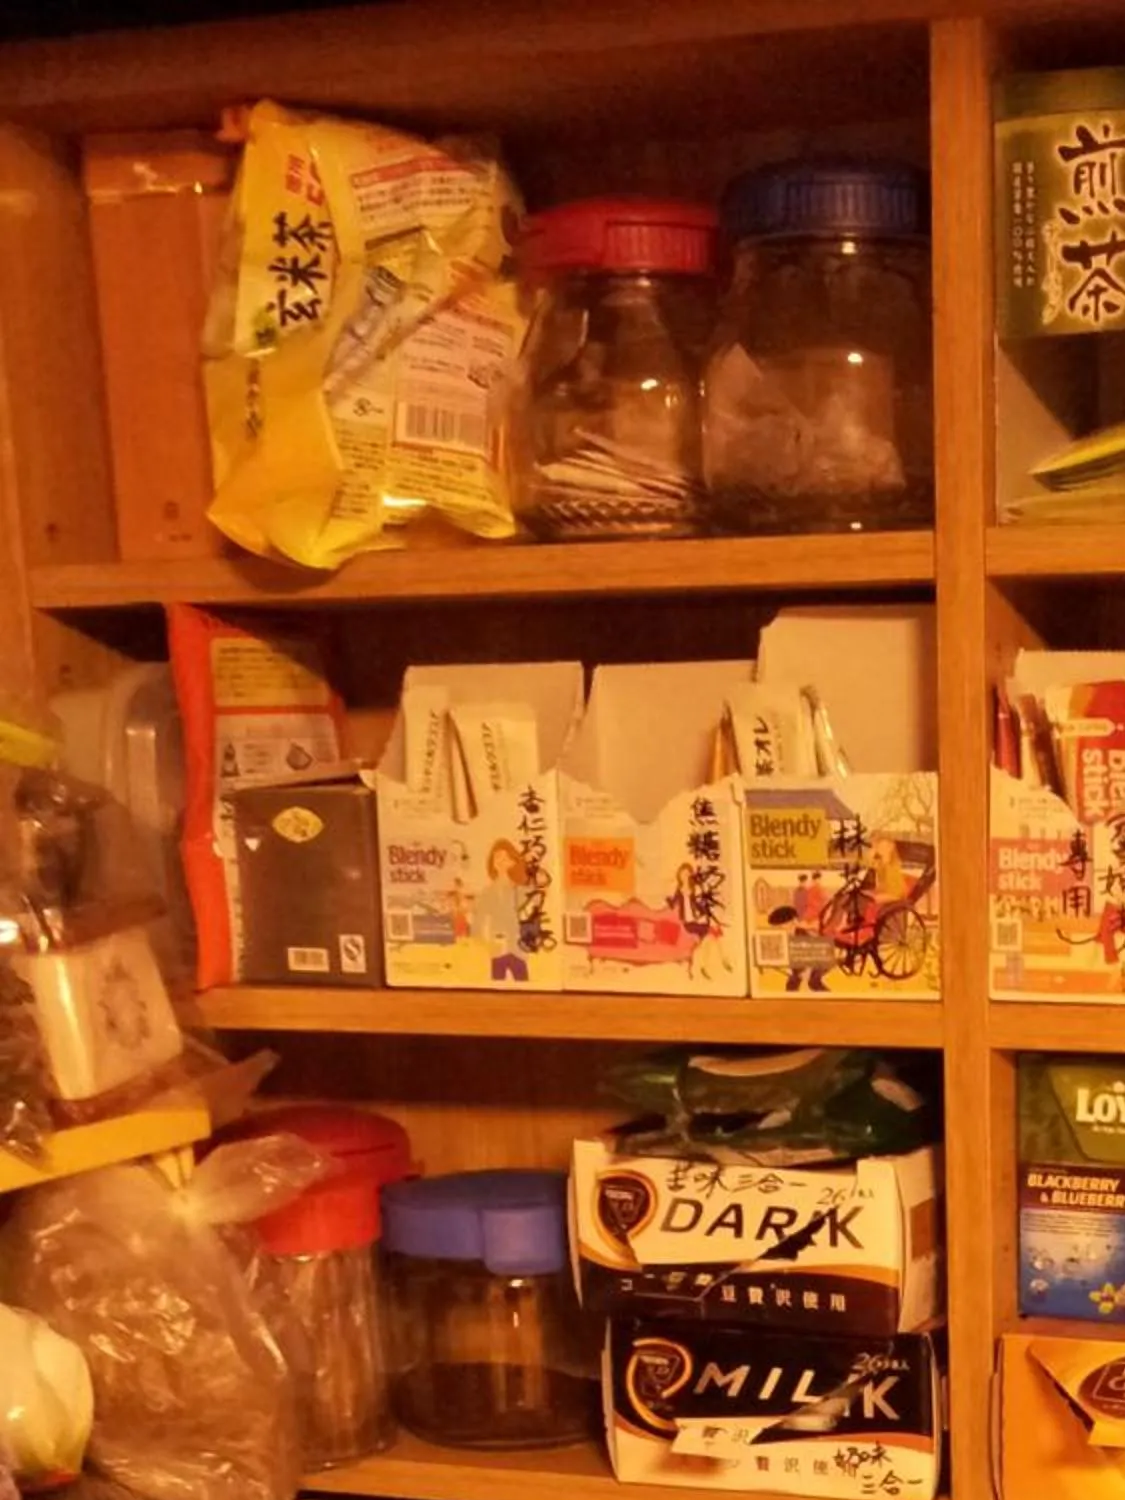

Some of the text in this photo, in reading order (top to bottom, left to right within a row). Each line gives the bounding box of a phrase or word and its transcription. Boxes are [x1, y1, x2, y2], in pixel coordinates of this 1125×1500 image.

[268, 211, 334, 327] 玄米茶
[749, 813, 823, 840] Blendy
[750, 838, 798, 860] stick
[1026, 1172, 1121, 1193] BLACKBERRY
[660, 1196, 865, 1250] DARK
[694, 1361, 900, 1421] MILK
